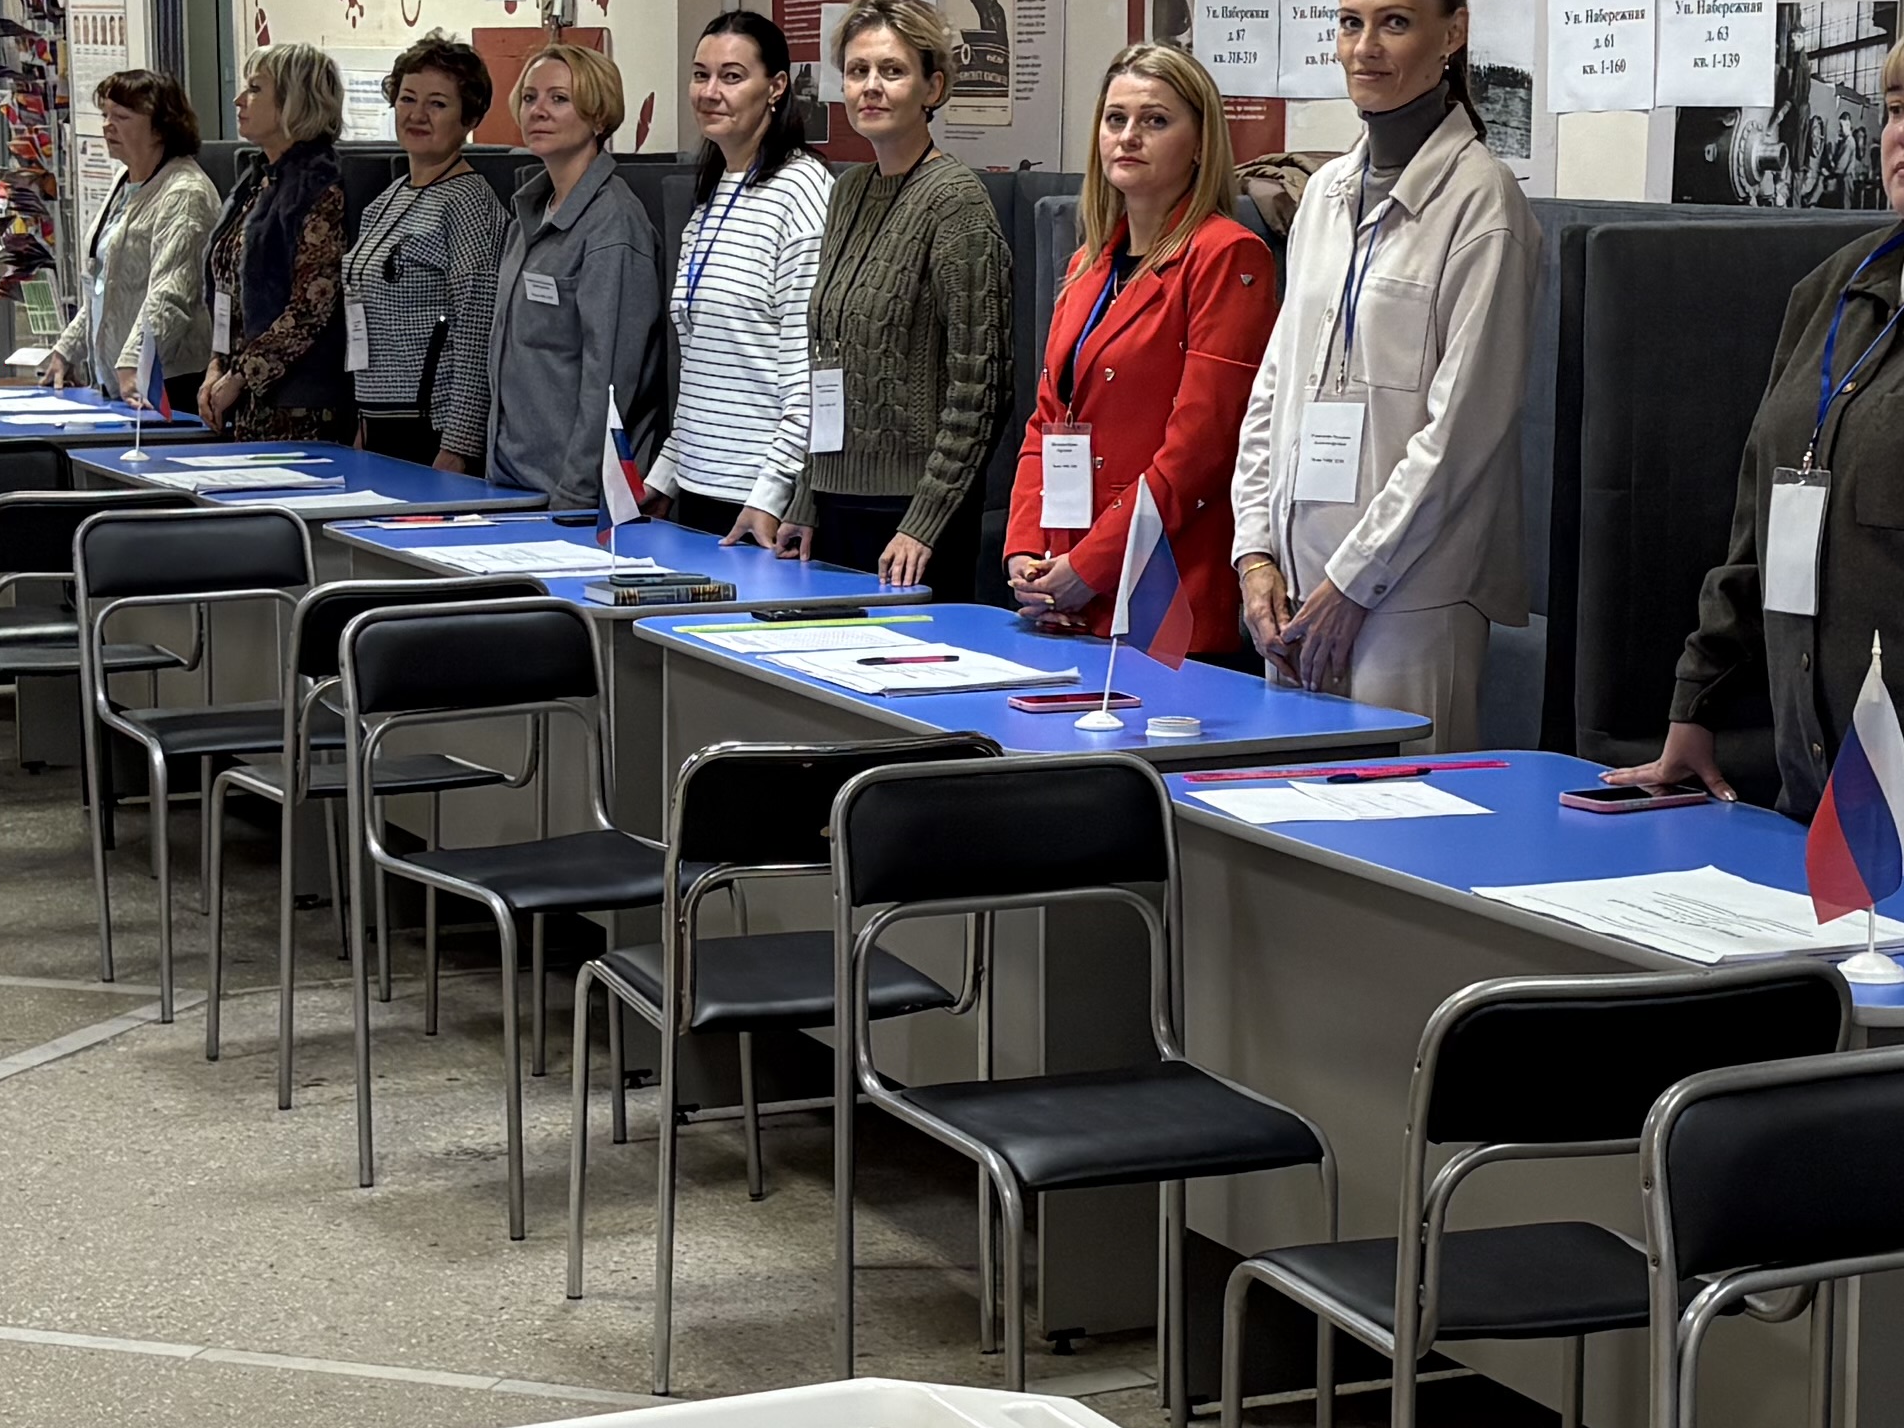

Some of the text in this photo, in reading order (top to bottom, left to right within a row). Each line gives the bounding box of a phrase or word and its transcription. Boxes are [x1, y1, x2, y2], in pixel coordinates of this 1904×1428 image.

[1586, 8, 1645, 25] Набережная
[1697, 0, 1762, 18] Набережная
[1712, 54, 1740, 68] 1-139
